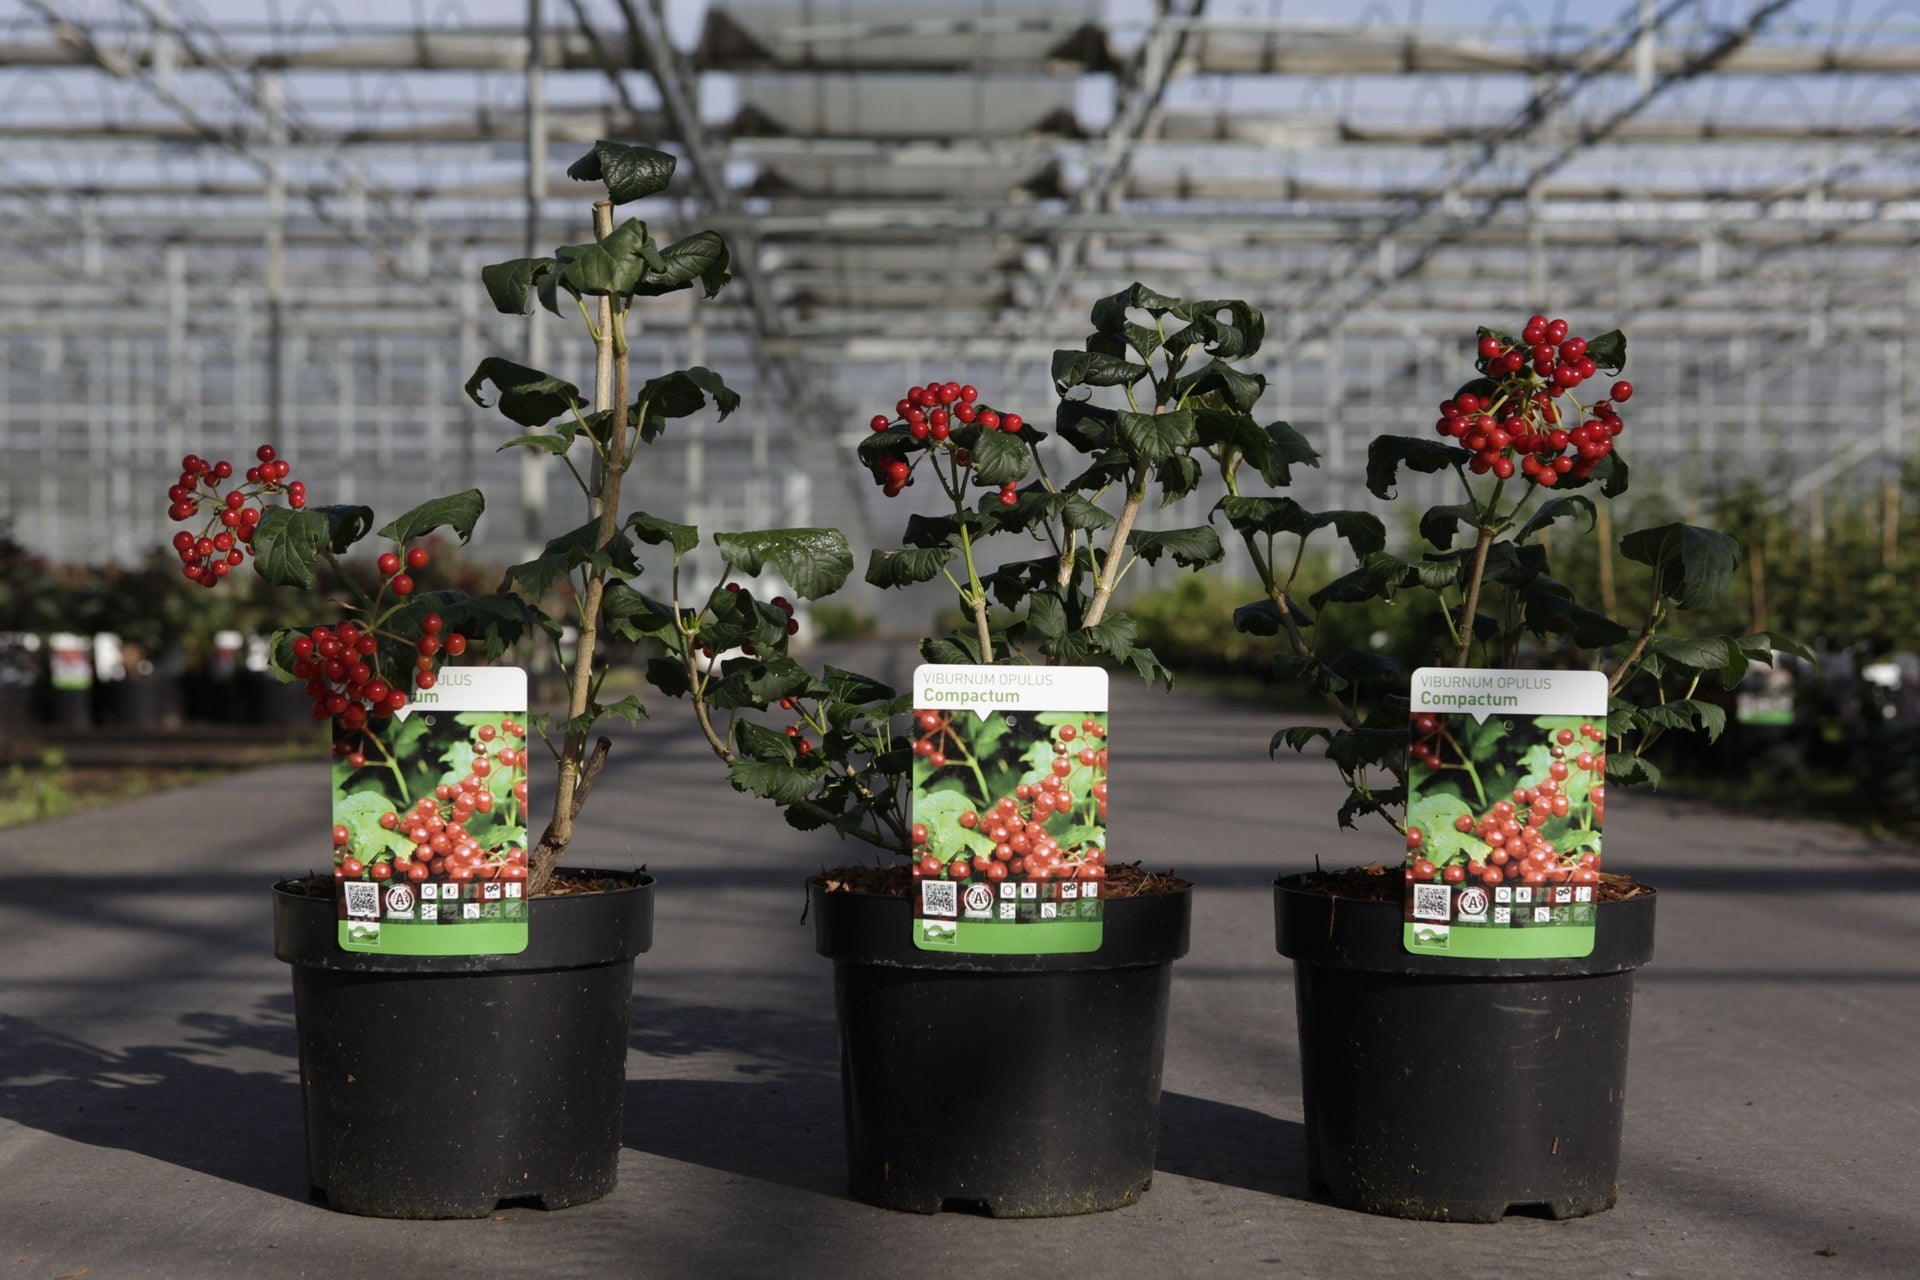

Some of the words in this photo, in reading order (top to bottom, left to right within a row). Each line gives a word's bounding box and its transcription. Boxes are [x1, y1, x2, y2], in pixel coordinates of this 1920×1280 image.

[436, 674, 472, 686] ULUS
[923, 672, 995, 685] VIBURNUM
[999, 673, 1053, 686] OPULUS
[1421, 676, 1493, 689] VIBURNUM
[1497, 677, 1552, 690] OPULUS
[924, 687, 1020, 705] Compactum
[1420, 691, 1518, 709] Compactum
